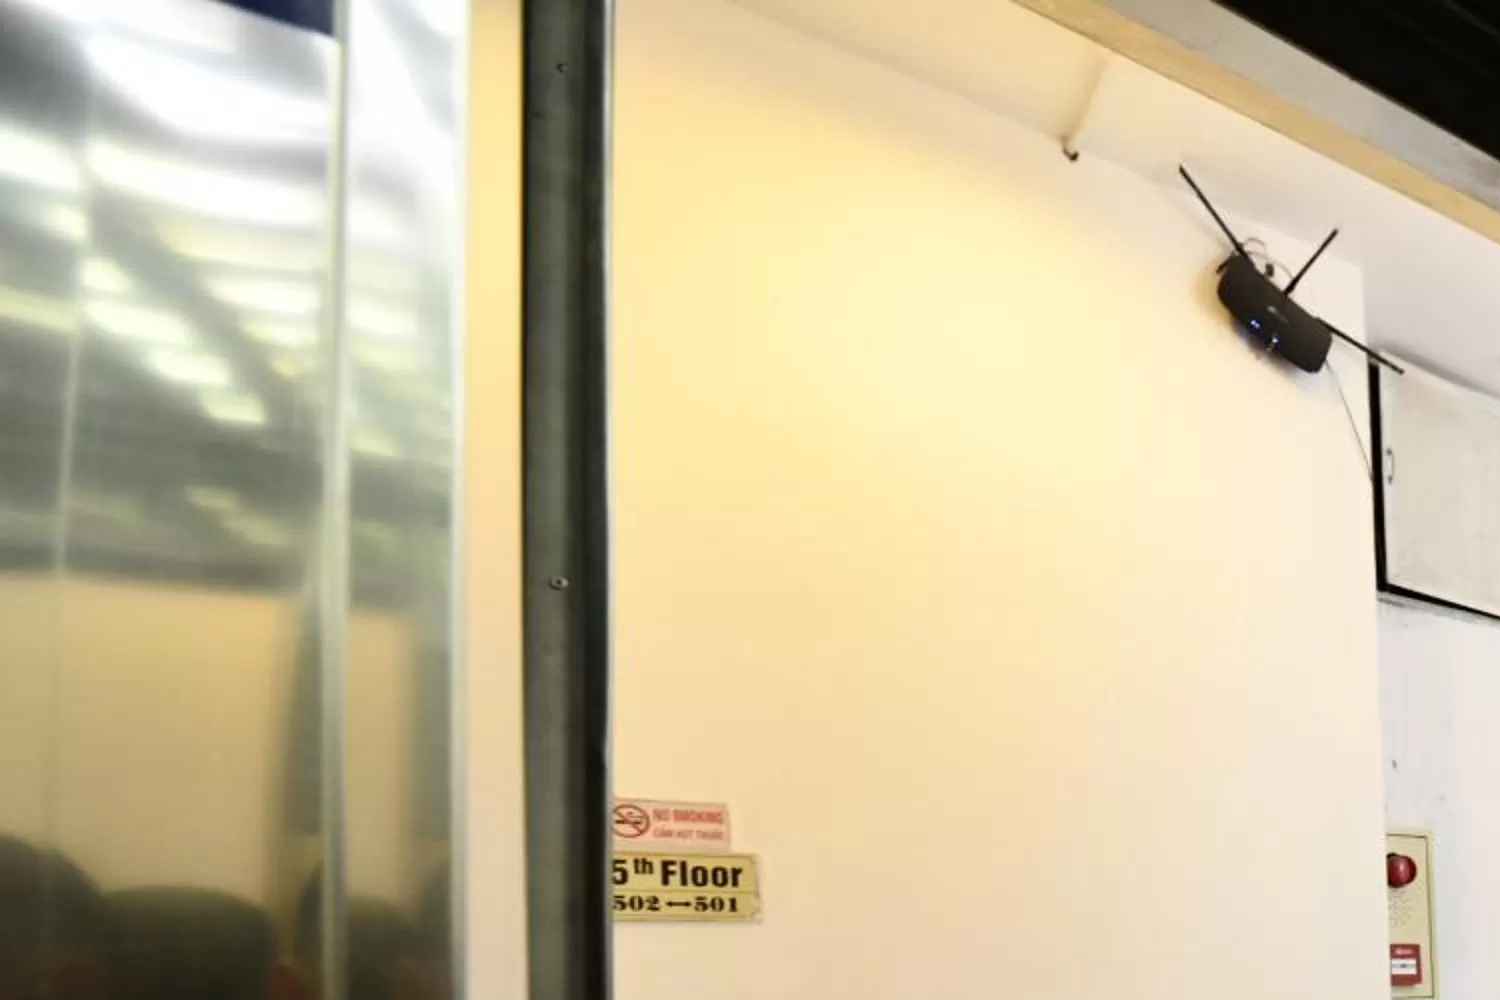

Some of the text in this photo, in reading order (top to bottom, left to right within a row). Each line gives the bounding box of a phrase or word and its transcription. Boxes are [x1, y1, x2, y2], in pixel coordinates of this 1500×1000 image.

[661, 860, 743, 888] Floor
[613, 895, 738, 913] 502 501
